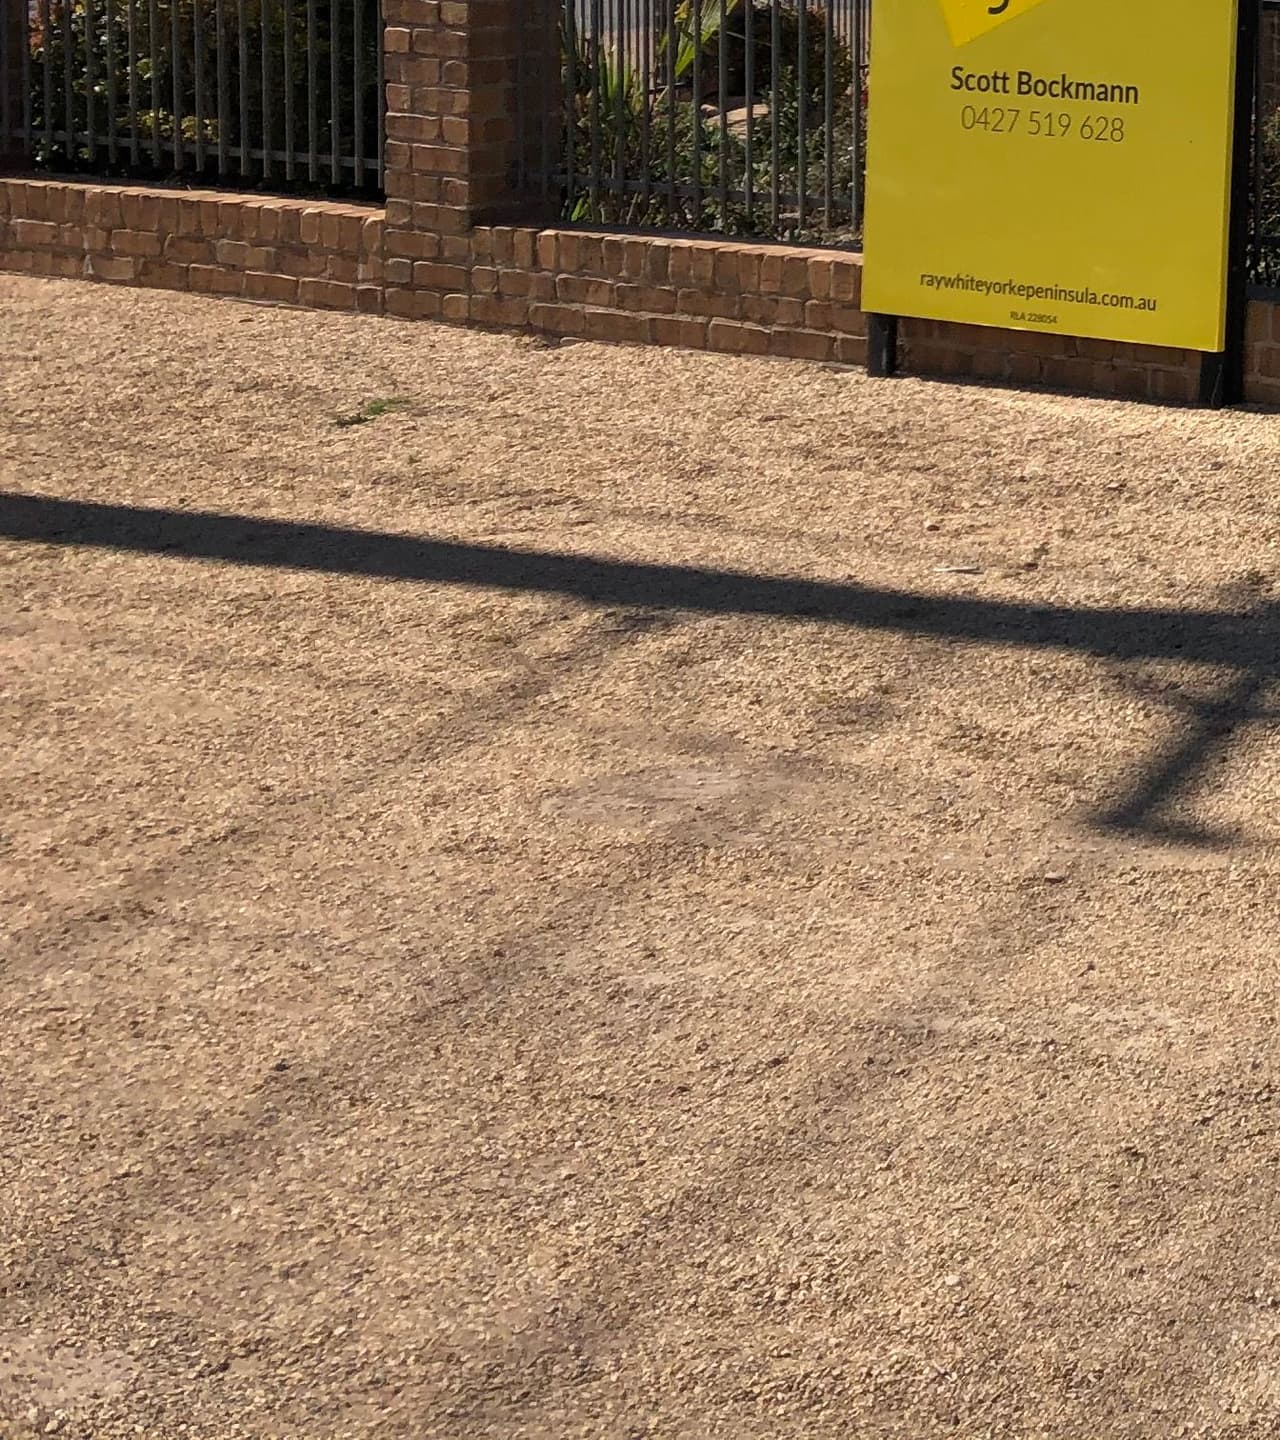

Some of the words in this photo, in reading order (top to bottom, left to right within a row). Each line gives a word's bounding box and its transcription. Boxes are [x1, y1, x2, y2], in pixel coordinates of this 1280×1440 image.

[950, 66, 1010, 94] Scott
[1016, 71, 1139, 105] Bockmann
[961, 105, 1020, 133] 0427
[1027, 111, 1072, 137] 519
[1079, 115, 1125, 143] 628
[920, 272, 1157, 312] raywhiteyorkepeninsula.com.au
